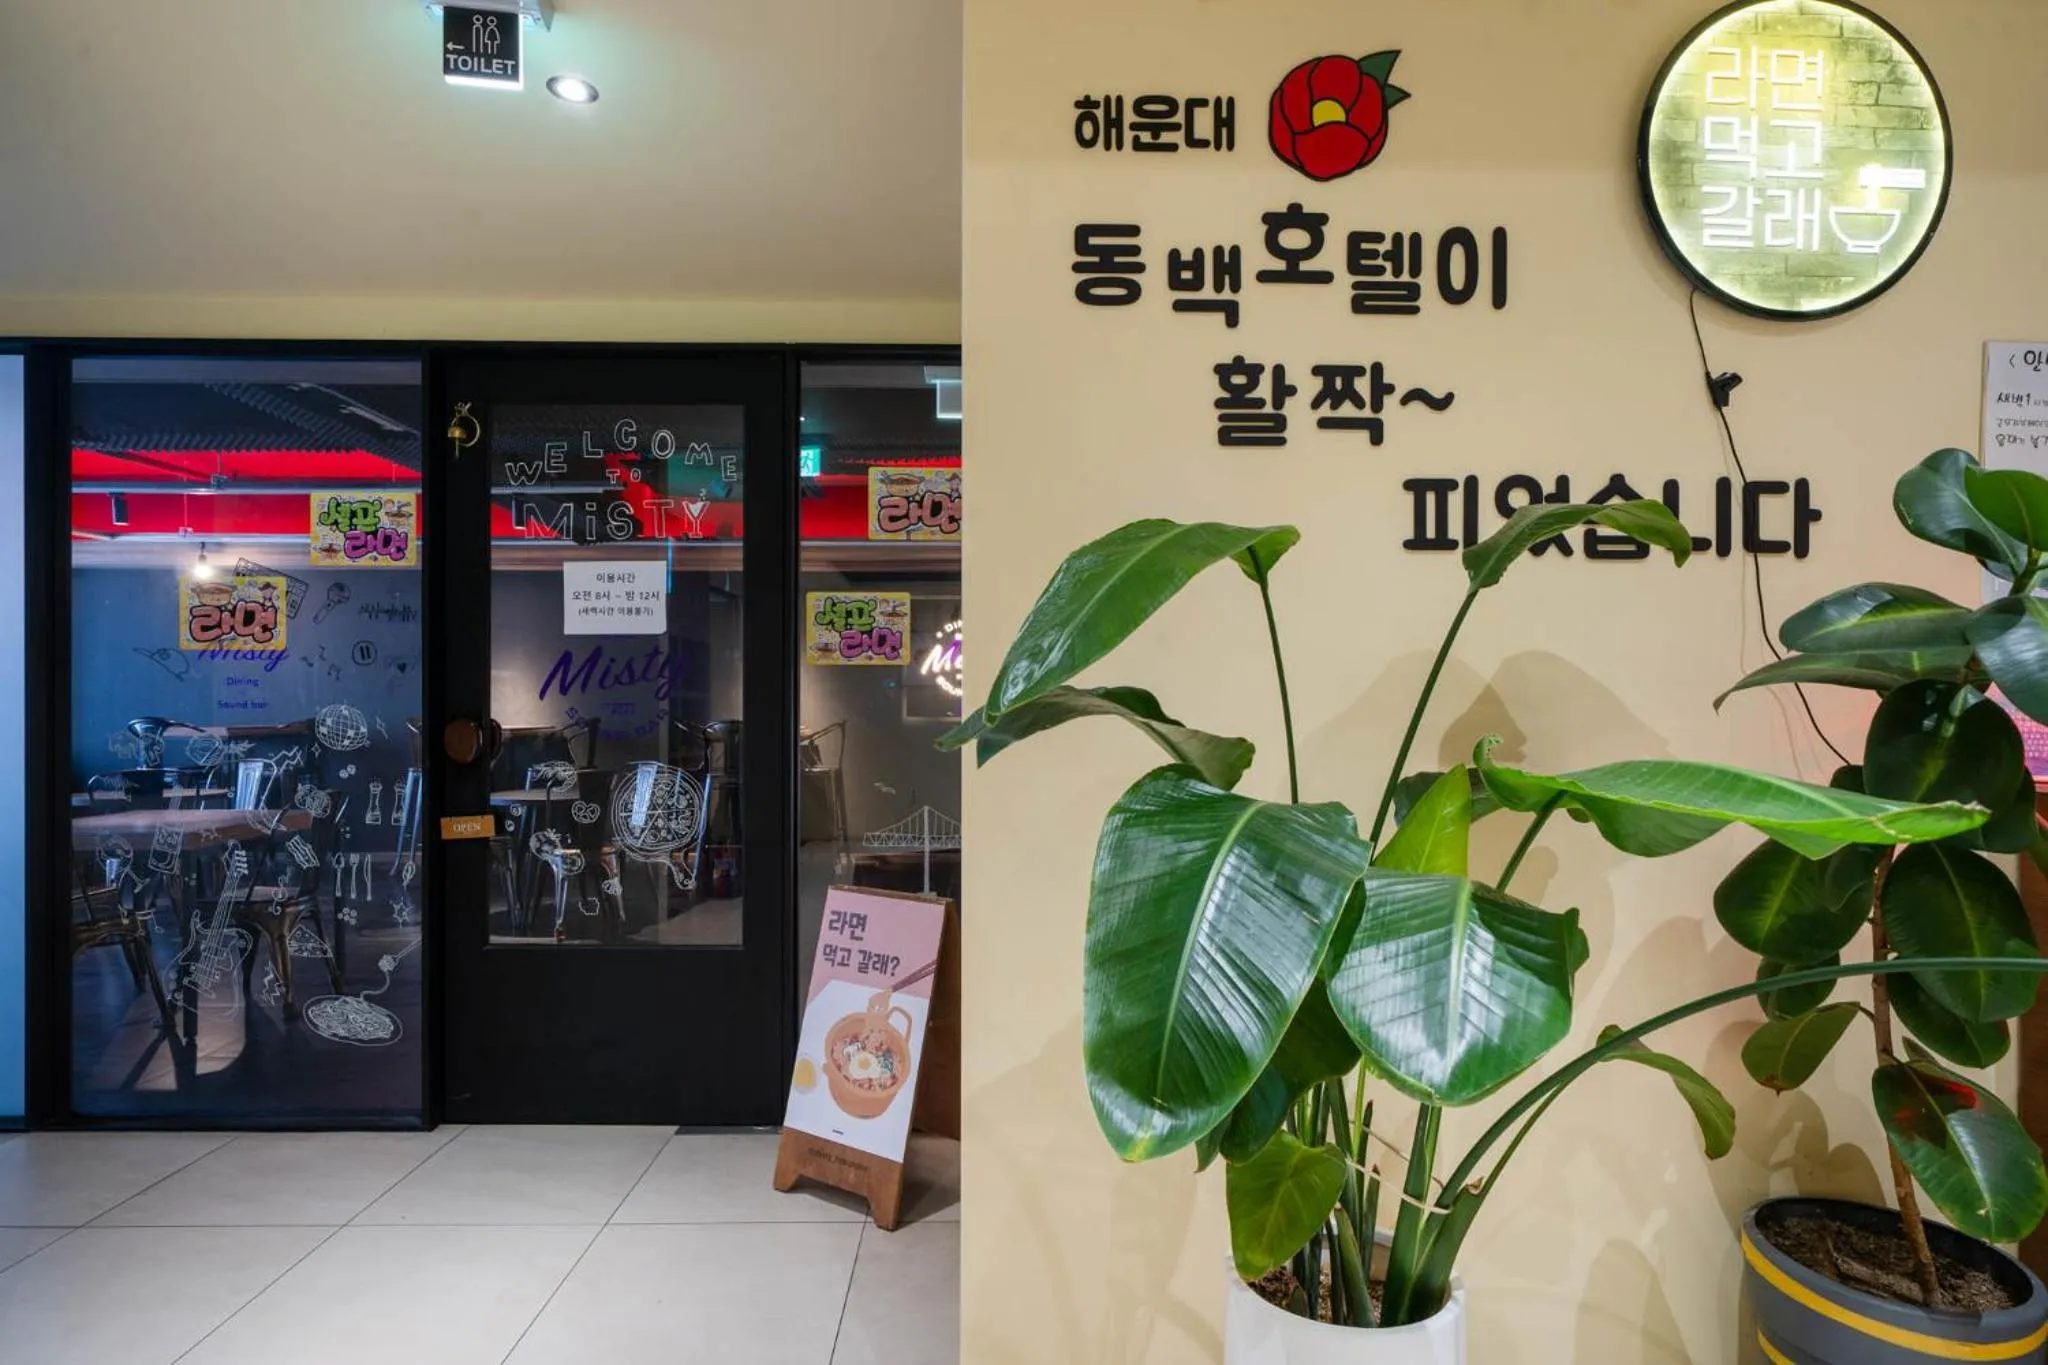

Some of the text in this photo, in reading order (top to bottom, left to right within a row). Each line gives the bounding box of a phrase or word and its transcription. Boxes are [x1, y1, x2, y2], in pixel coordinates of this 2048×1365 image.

[446, 54, 515, 75] TOILET
[1705, 46, 1824, 111] 라면
[1073, 94, 1235, 153] 해운대
[1704, 116, 1824, 179] 먹고
[1701, 186, 1821, 250] 갈래
[1072, 202, 1508, 328] 동백호텔이
[2023, 350, 2048, 372] 안
[505, 418, 738, 486] WELCOME
[606, 467, 641, 485] TO
[318, 497, 383, 533] 셀프
[877, 491, 962, 534] 라면
[343, 526, 409, 562] 라면
[572, 590, 592, 601] 오전
[625, 590, 635, 601] 밤
[639, 590, 660, 601] 12시
[596, 572, 636, 584] 이용시간
[189, 600, 278, 643] 라면
[815, 596, 877, 632] 셀프
[839, 627, 904, 661] 라면
[226, 676, 260, 687] Dining
[538, 644, 688, 701] Misty
[217, 700, 248, 709] Sound
[453, 822, 482, 833] OPEN
[827, 909, 868, 942] 라면
[822, 943, 900, 977] 먹고 갈래?
